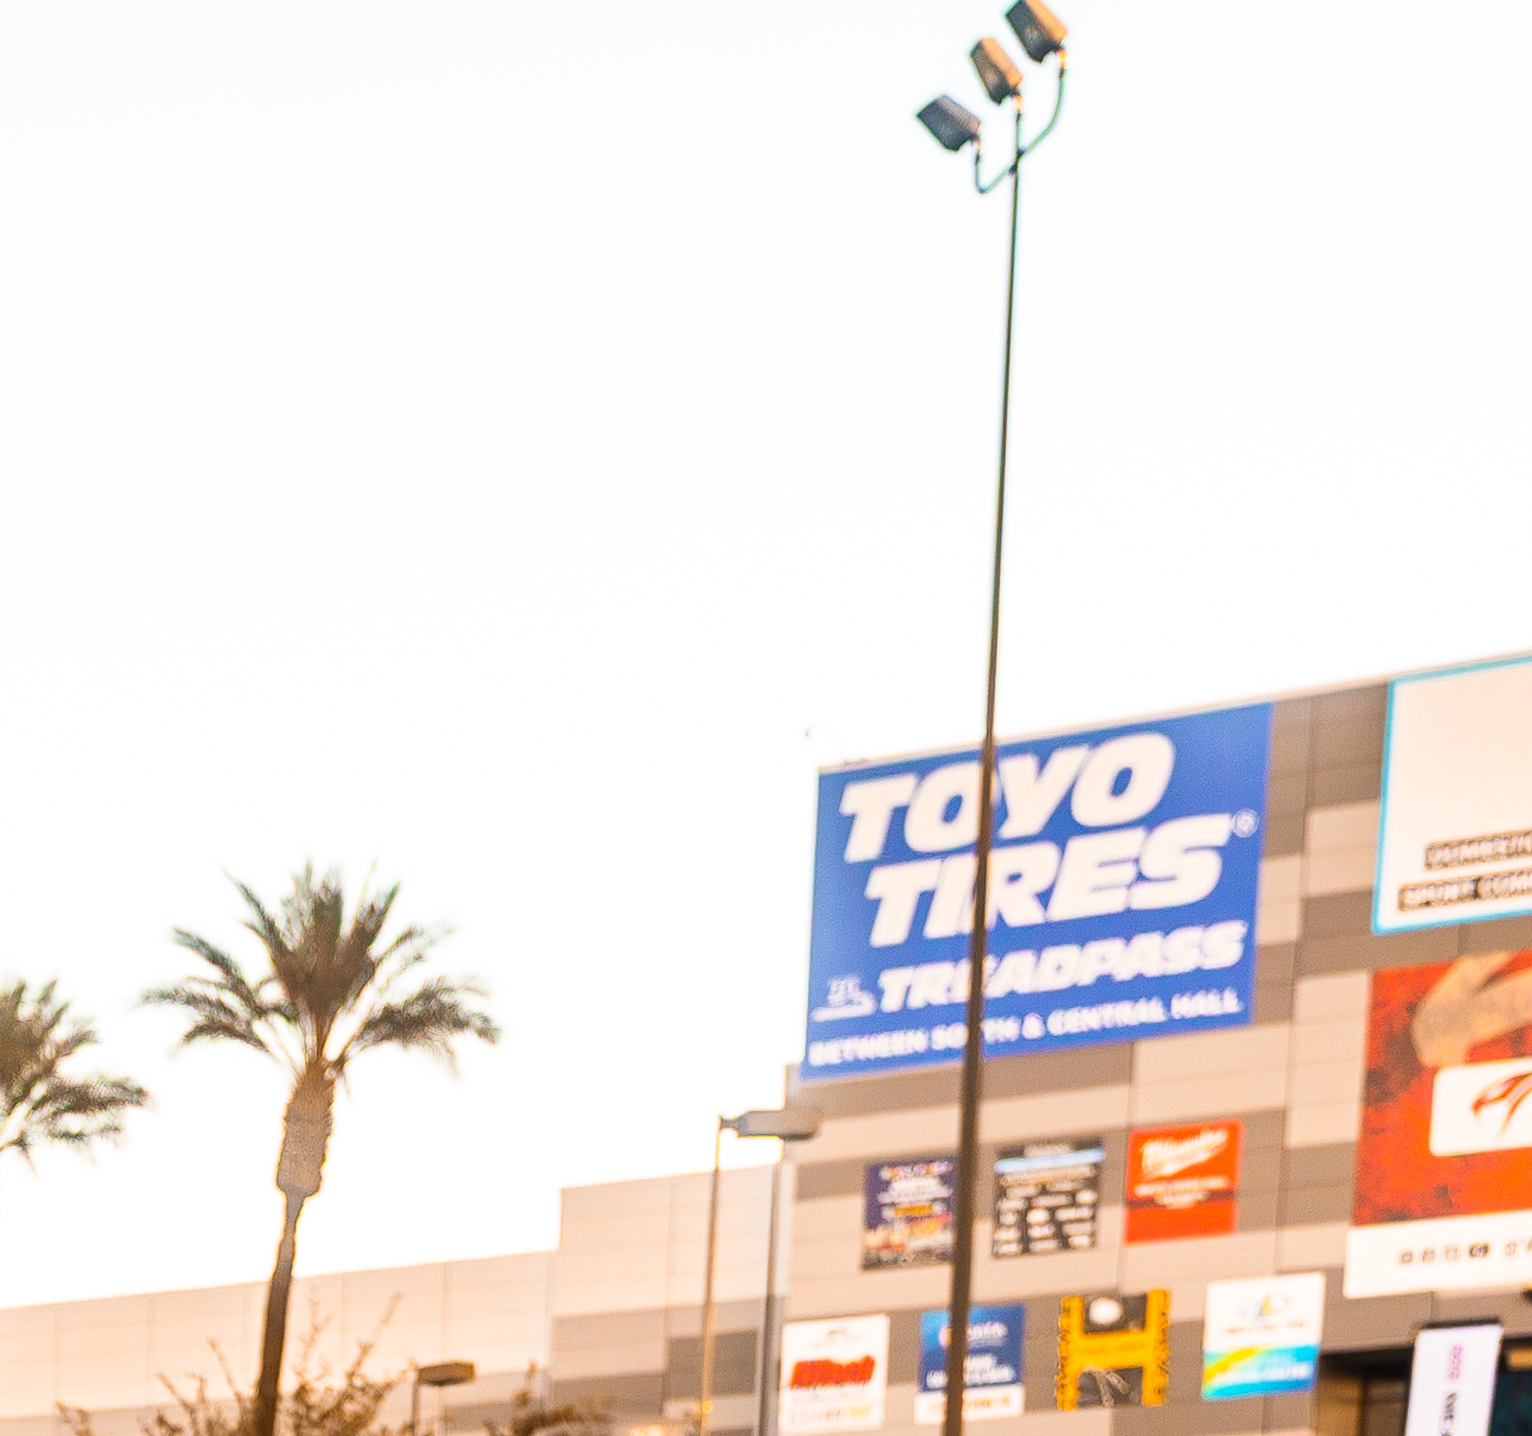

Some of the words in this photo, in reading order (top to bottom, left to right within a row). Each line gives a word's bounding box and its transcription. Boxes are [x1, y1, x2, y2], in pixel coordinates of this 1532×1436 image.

[839, 732, 1175, 864] TOYO
[864, 813, 1235, 949] TIRES
[877, 920, 1248, 1013] TREADPASS
[808, 1028, 929, 1067] BETWEEN
[931, 1017, 1021, 1051] SOTH
[1046, 996, 1169, 1037] CENTRAL
